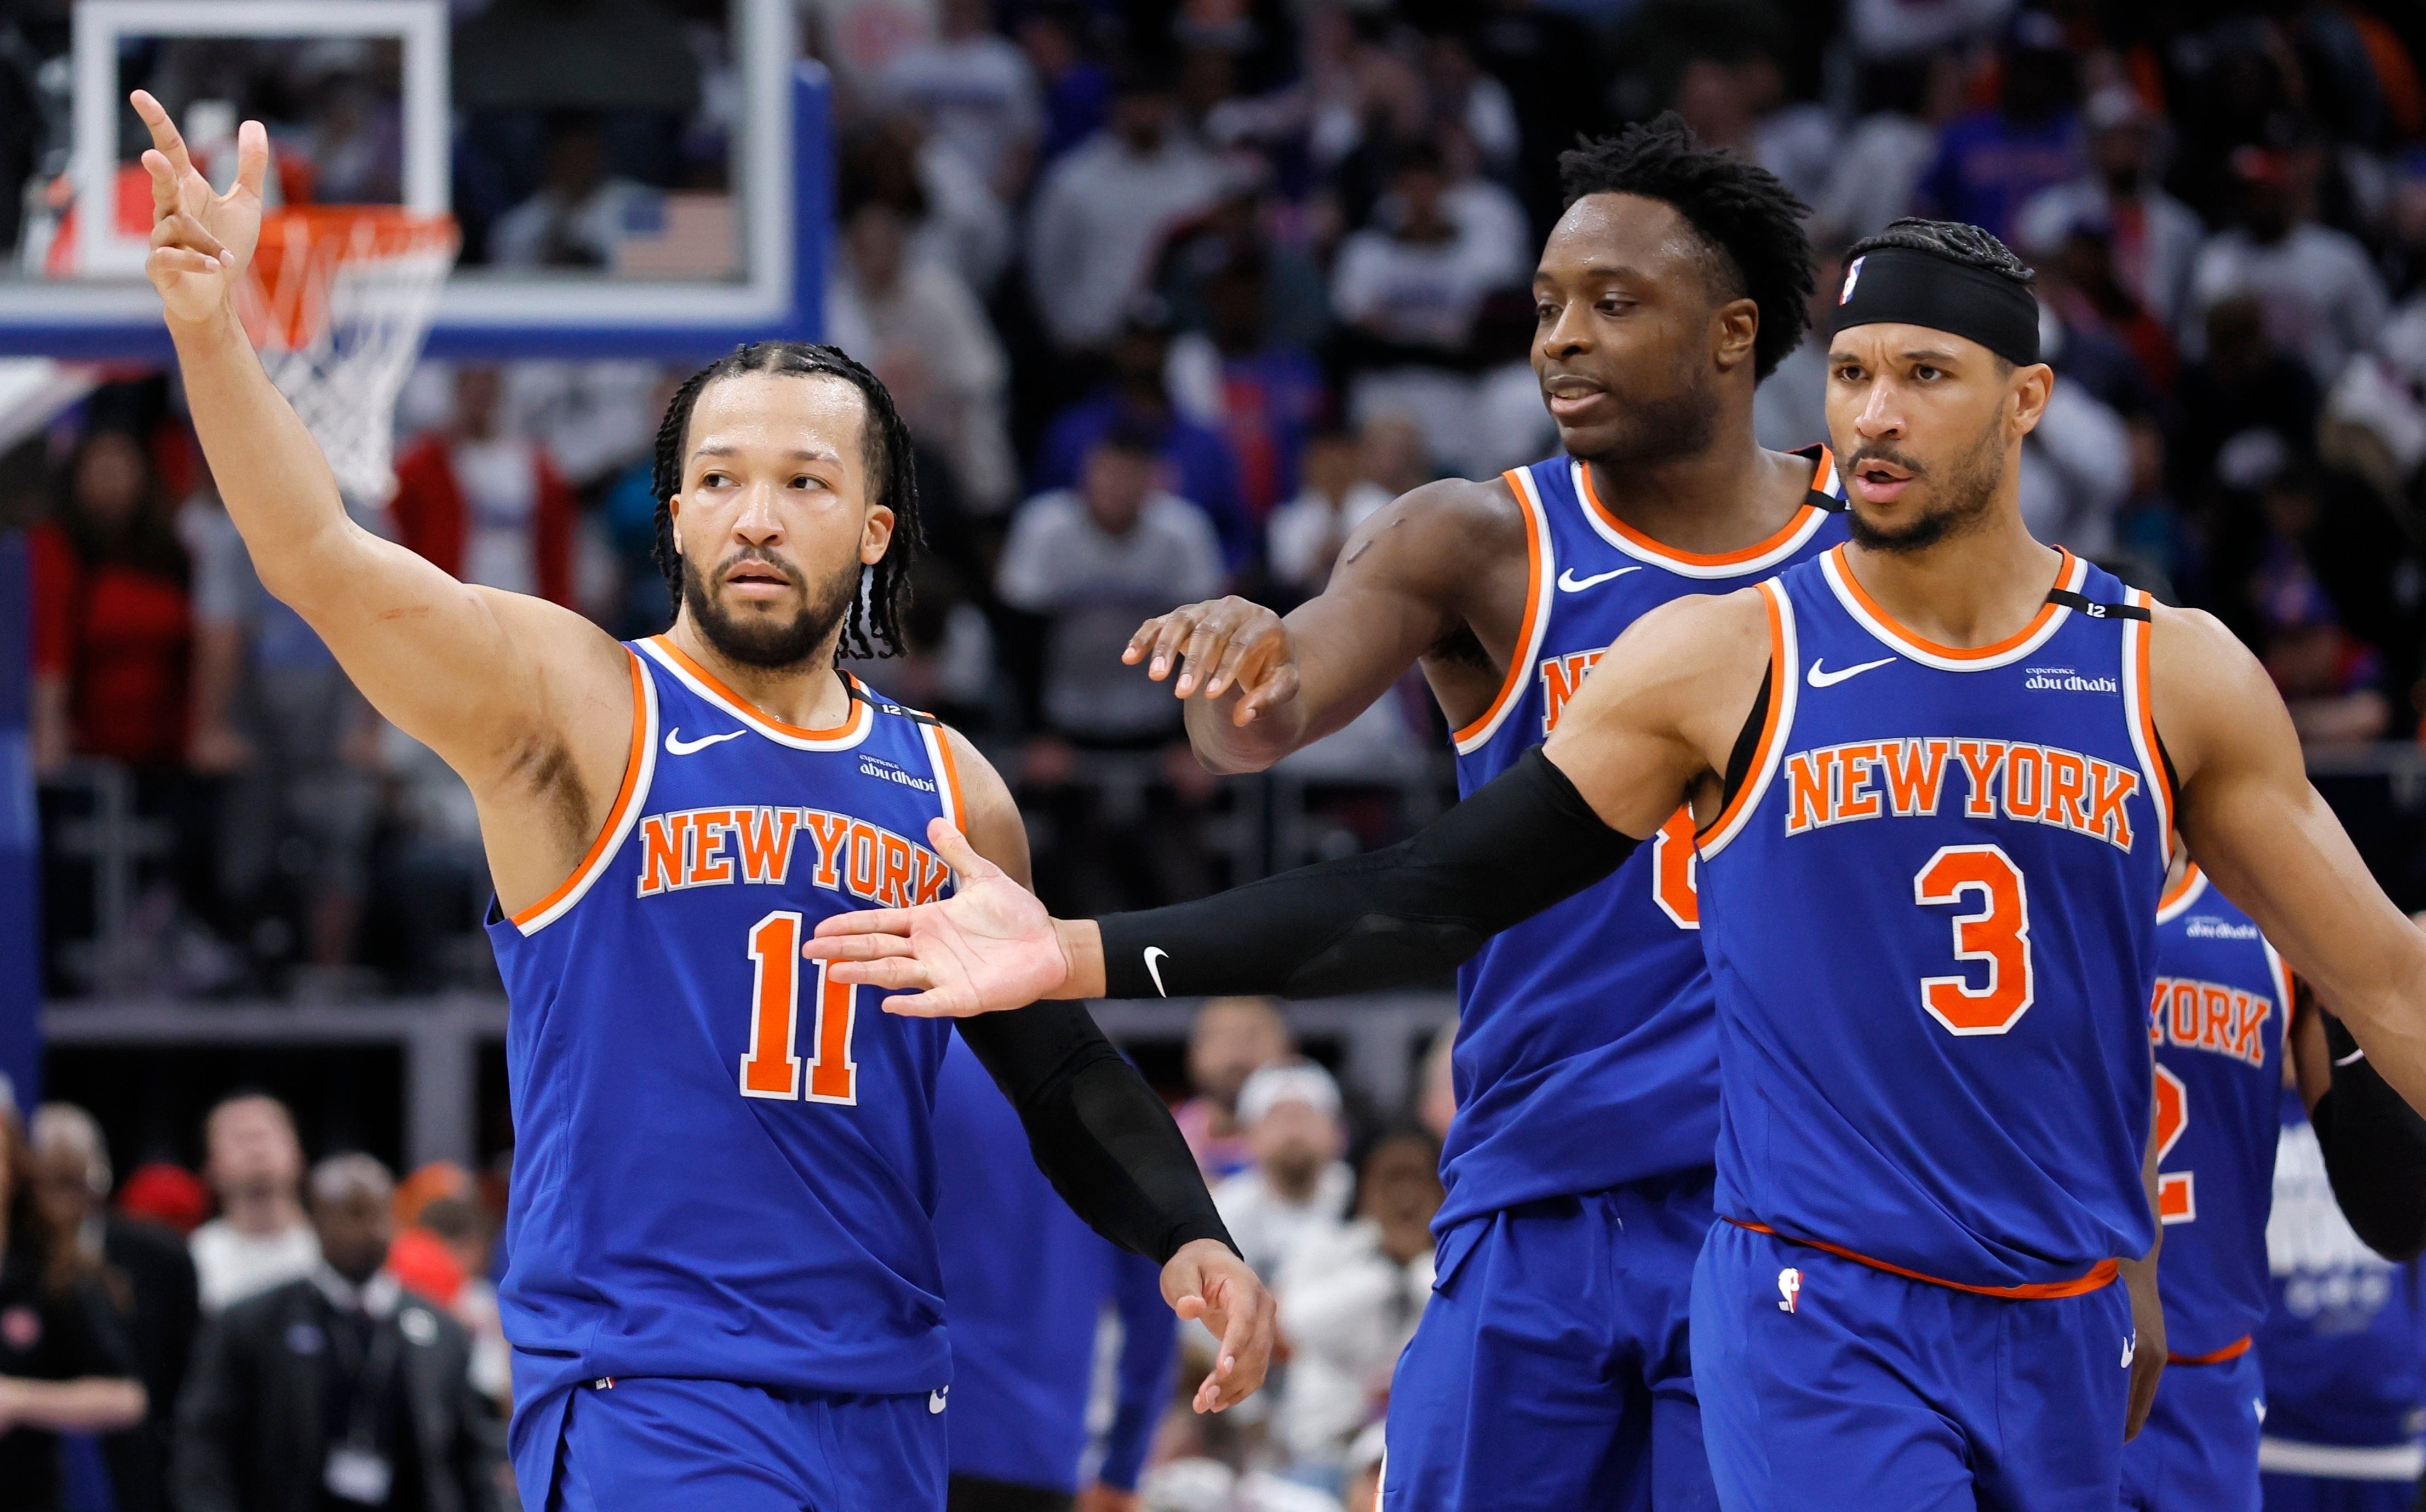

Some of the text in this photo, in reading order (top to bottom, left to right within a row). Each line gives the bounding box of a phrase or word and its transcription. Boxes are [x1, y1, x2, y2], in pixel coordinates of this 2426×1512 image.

[2086, 602, 2106, 618] 12
[2026, 675, 2117, 692] abu dhabi
[882, 704, 902, 716] 12
[859, 754, 899, 769] experience
[860, 763, 936, 792] abu dhabi
[1785, 737, 2140, 854] NEW YORK
[637, 806, 802, 899] NEW
[1914, 844, 2034, 1037] 3
[740, 910, 857, 1106] 11
